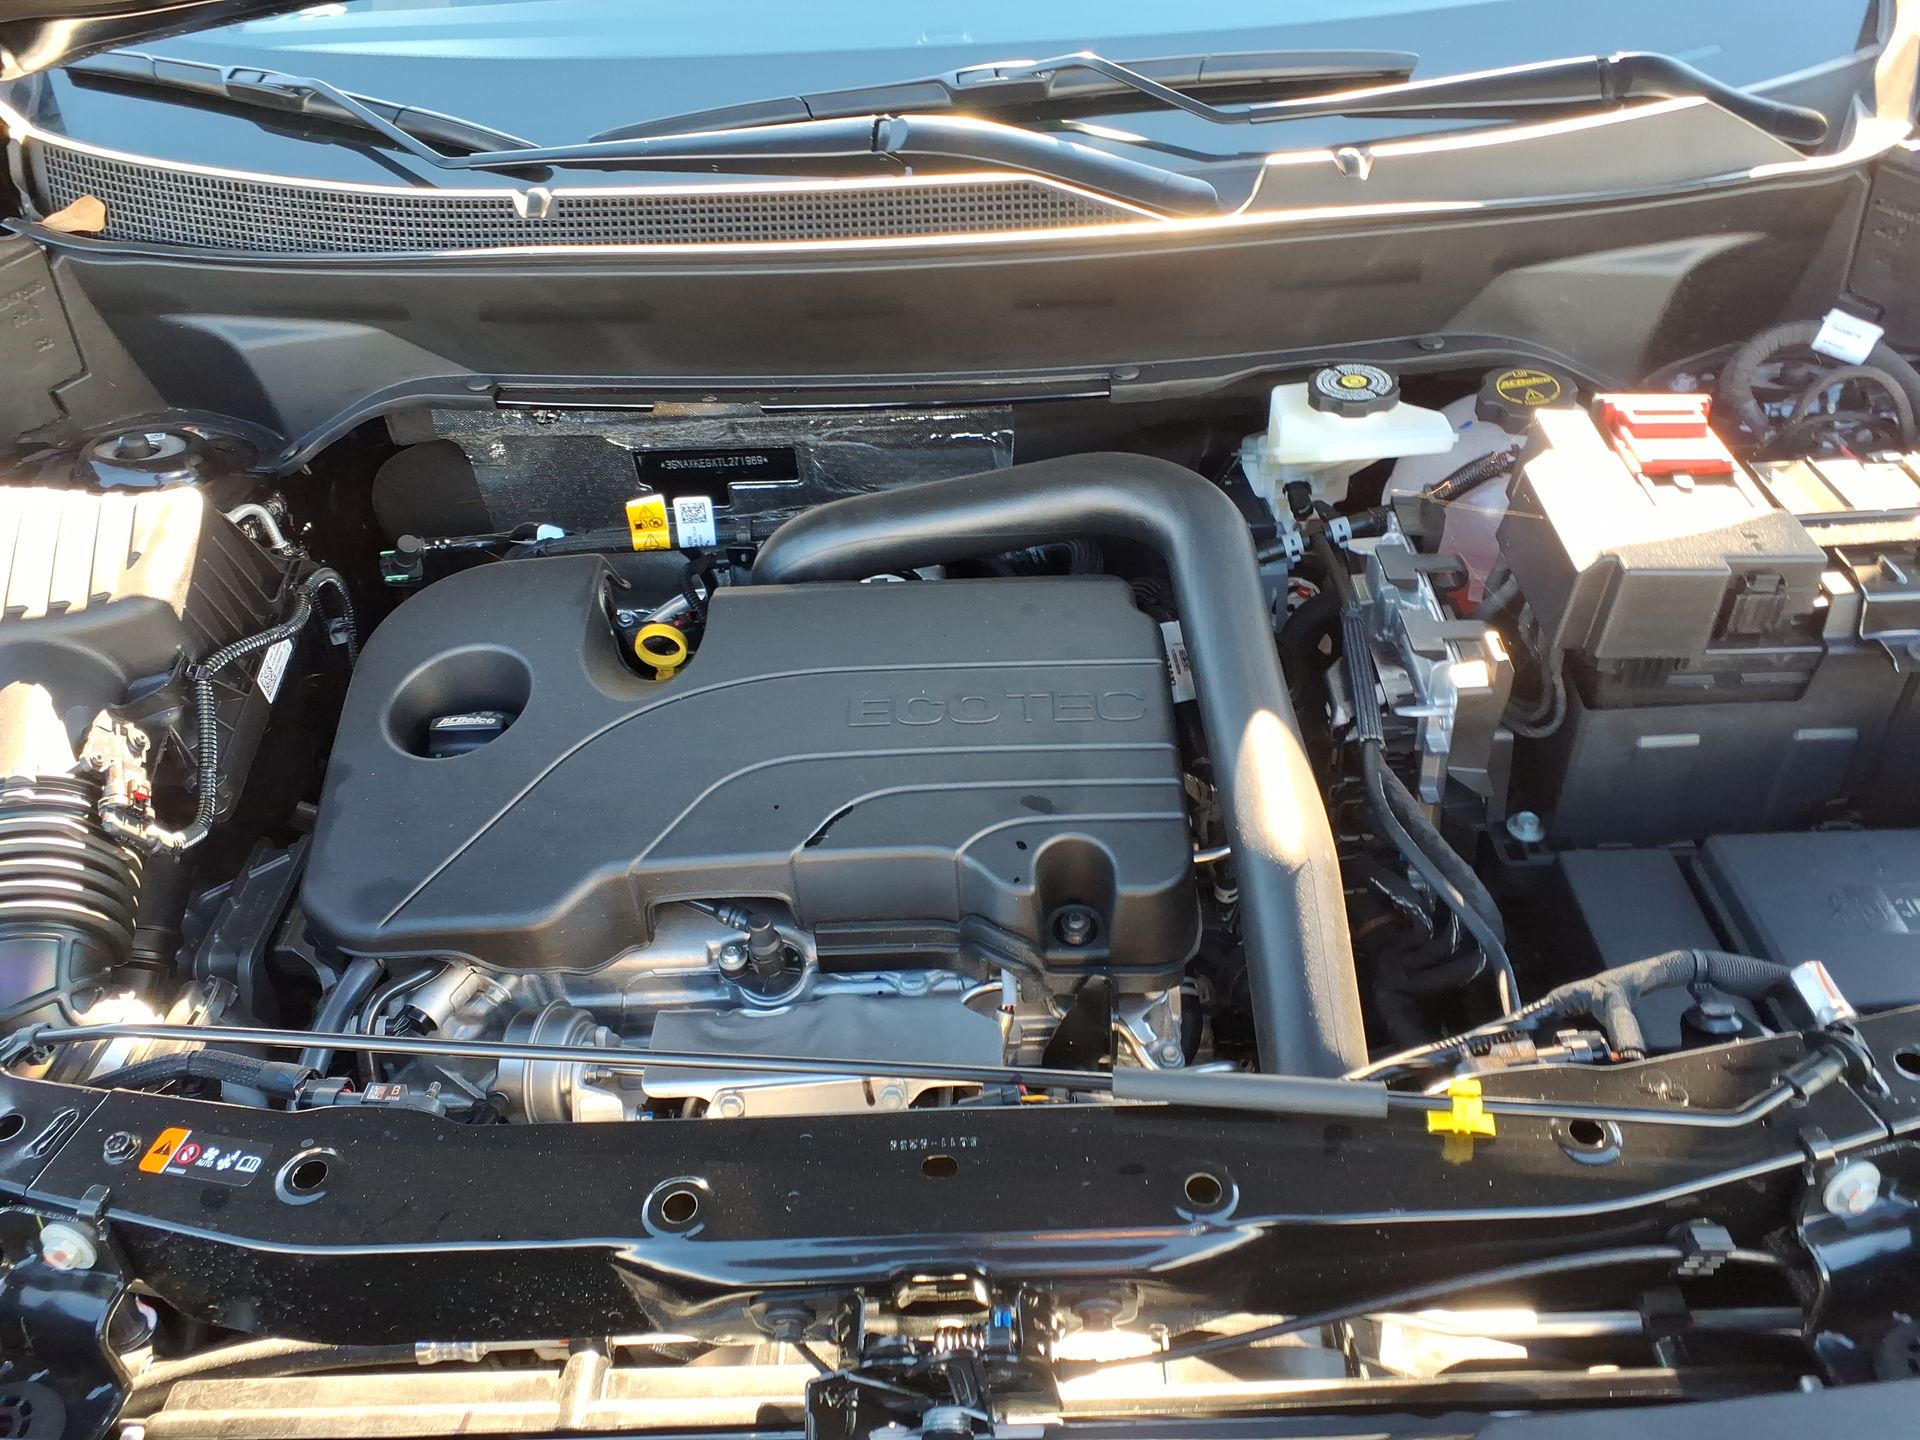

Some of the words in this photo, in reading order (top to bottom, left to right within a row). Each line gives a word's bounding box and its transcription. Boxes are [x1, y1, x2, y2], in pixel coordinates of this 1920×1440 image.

[846, 691, 1148, 726] ECOTEC
[437, 715, 496, 727] ACDelco
[195, 1159, 214, 1168] AUTO
